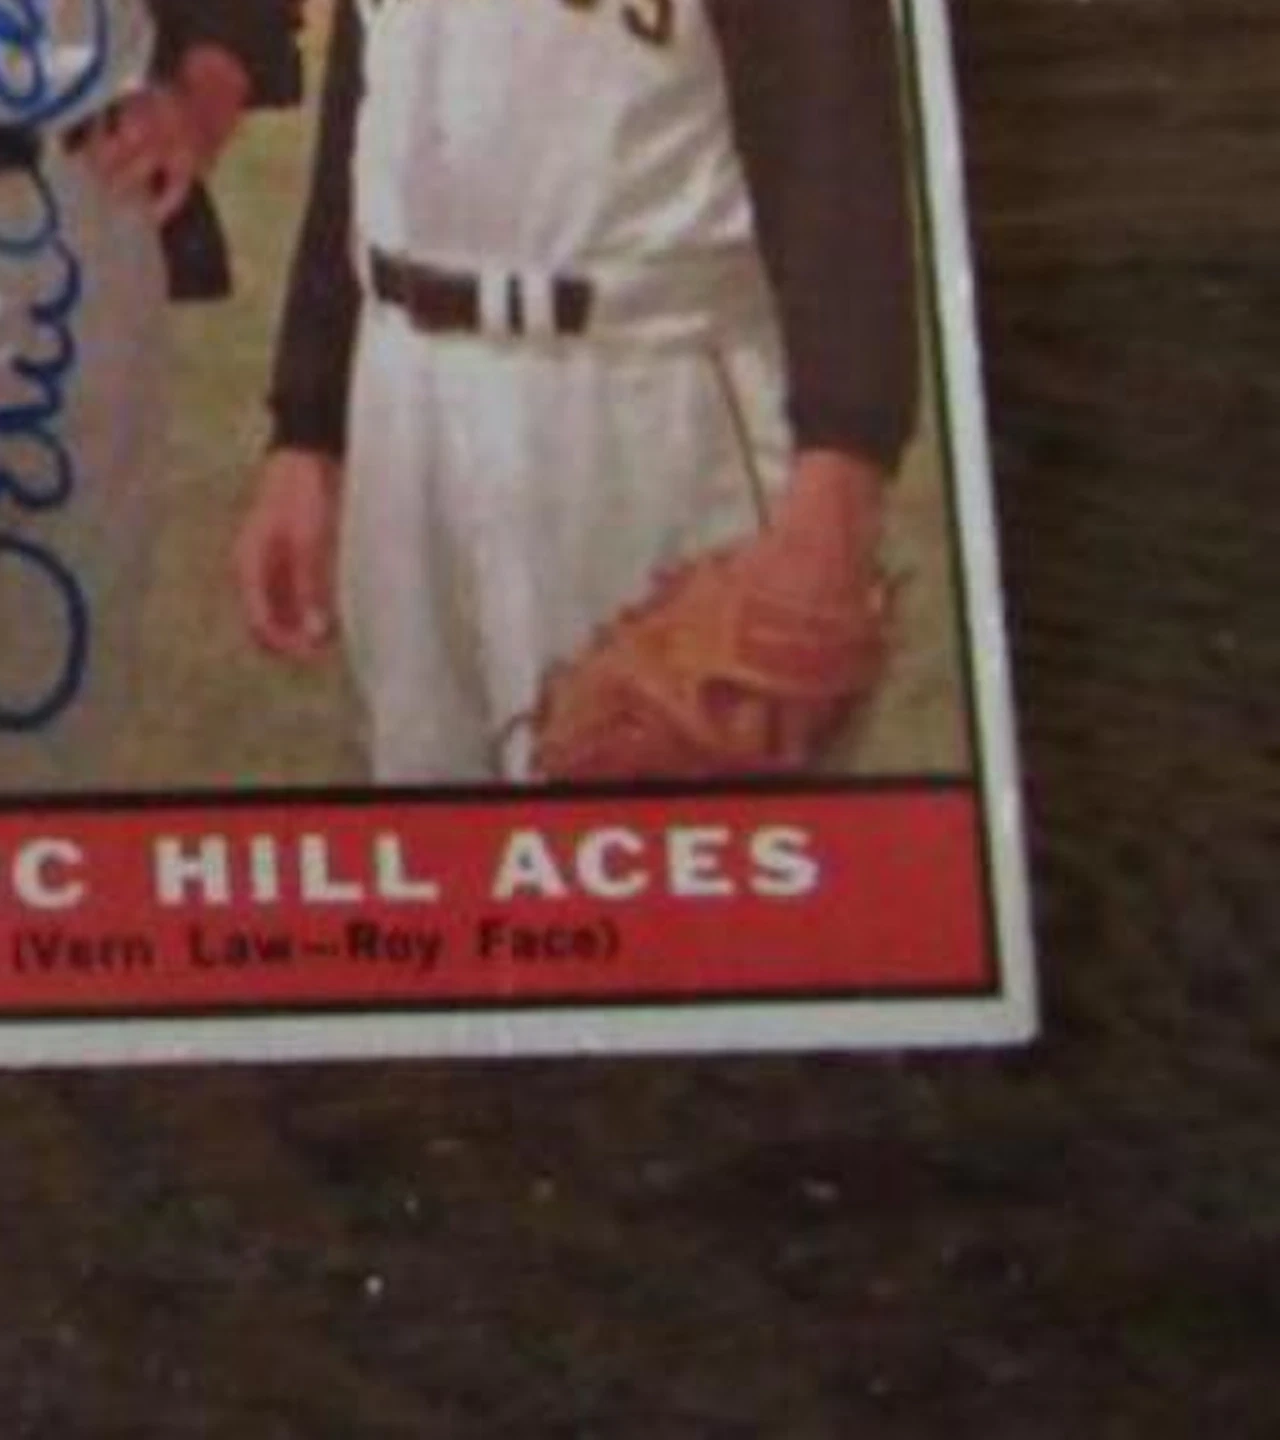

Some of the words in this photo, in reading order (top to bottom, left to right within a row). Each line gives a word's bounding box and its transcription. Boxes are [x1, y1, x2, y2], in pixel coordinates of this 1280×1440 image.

[153, 830, 438, 907] HILL
[489, 824, 821, 902] ACES
[477, 914, 622, 964] Face)
